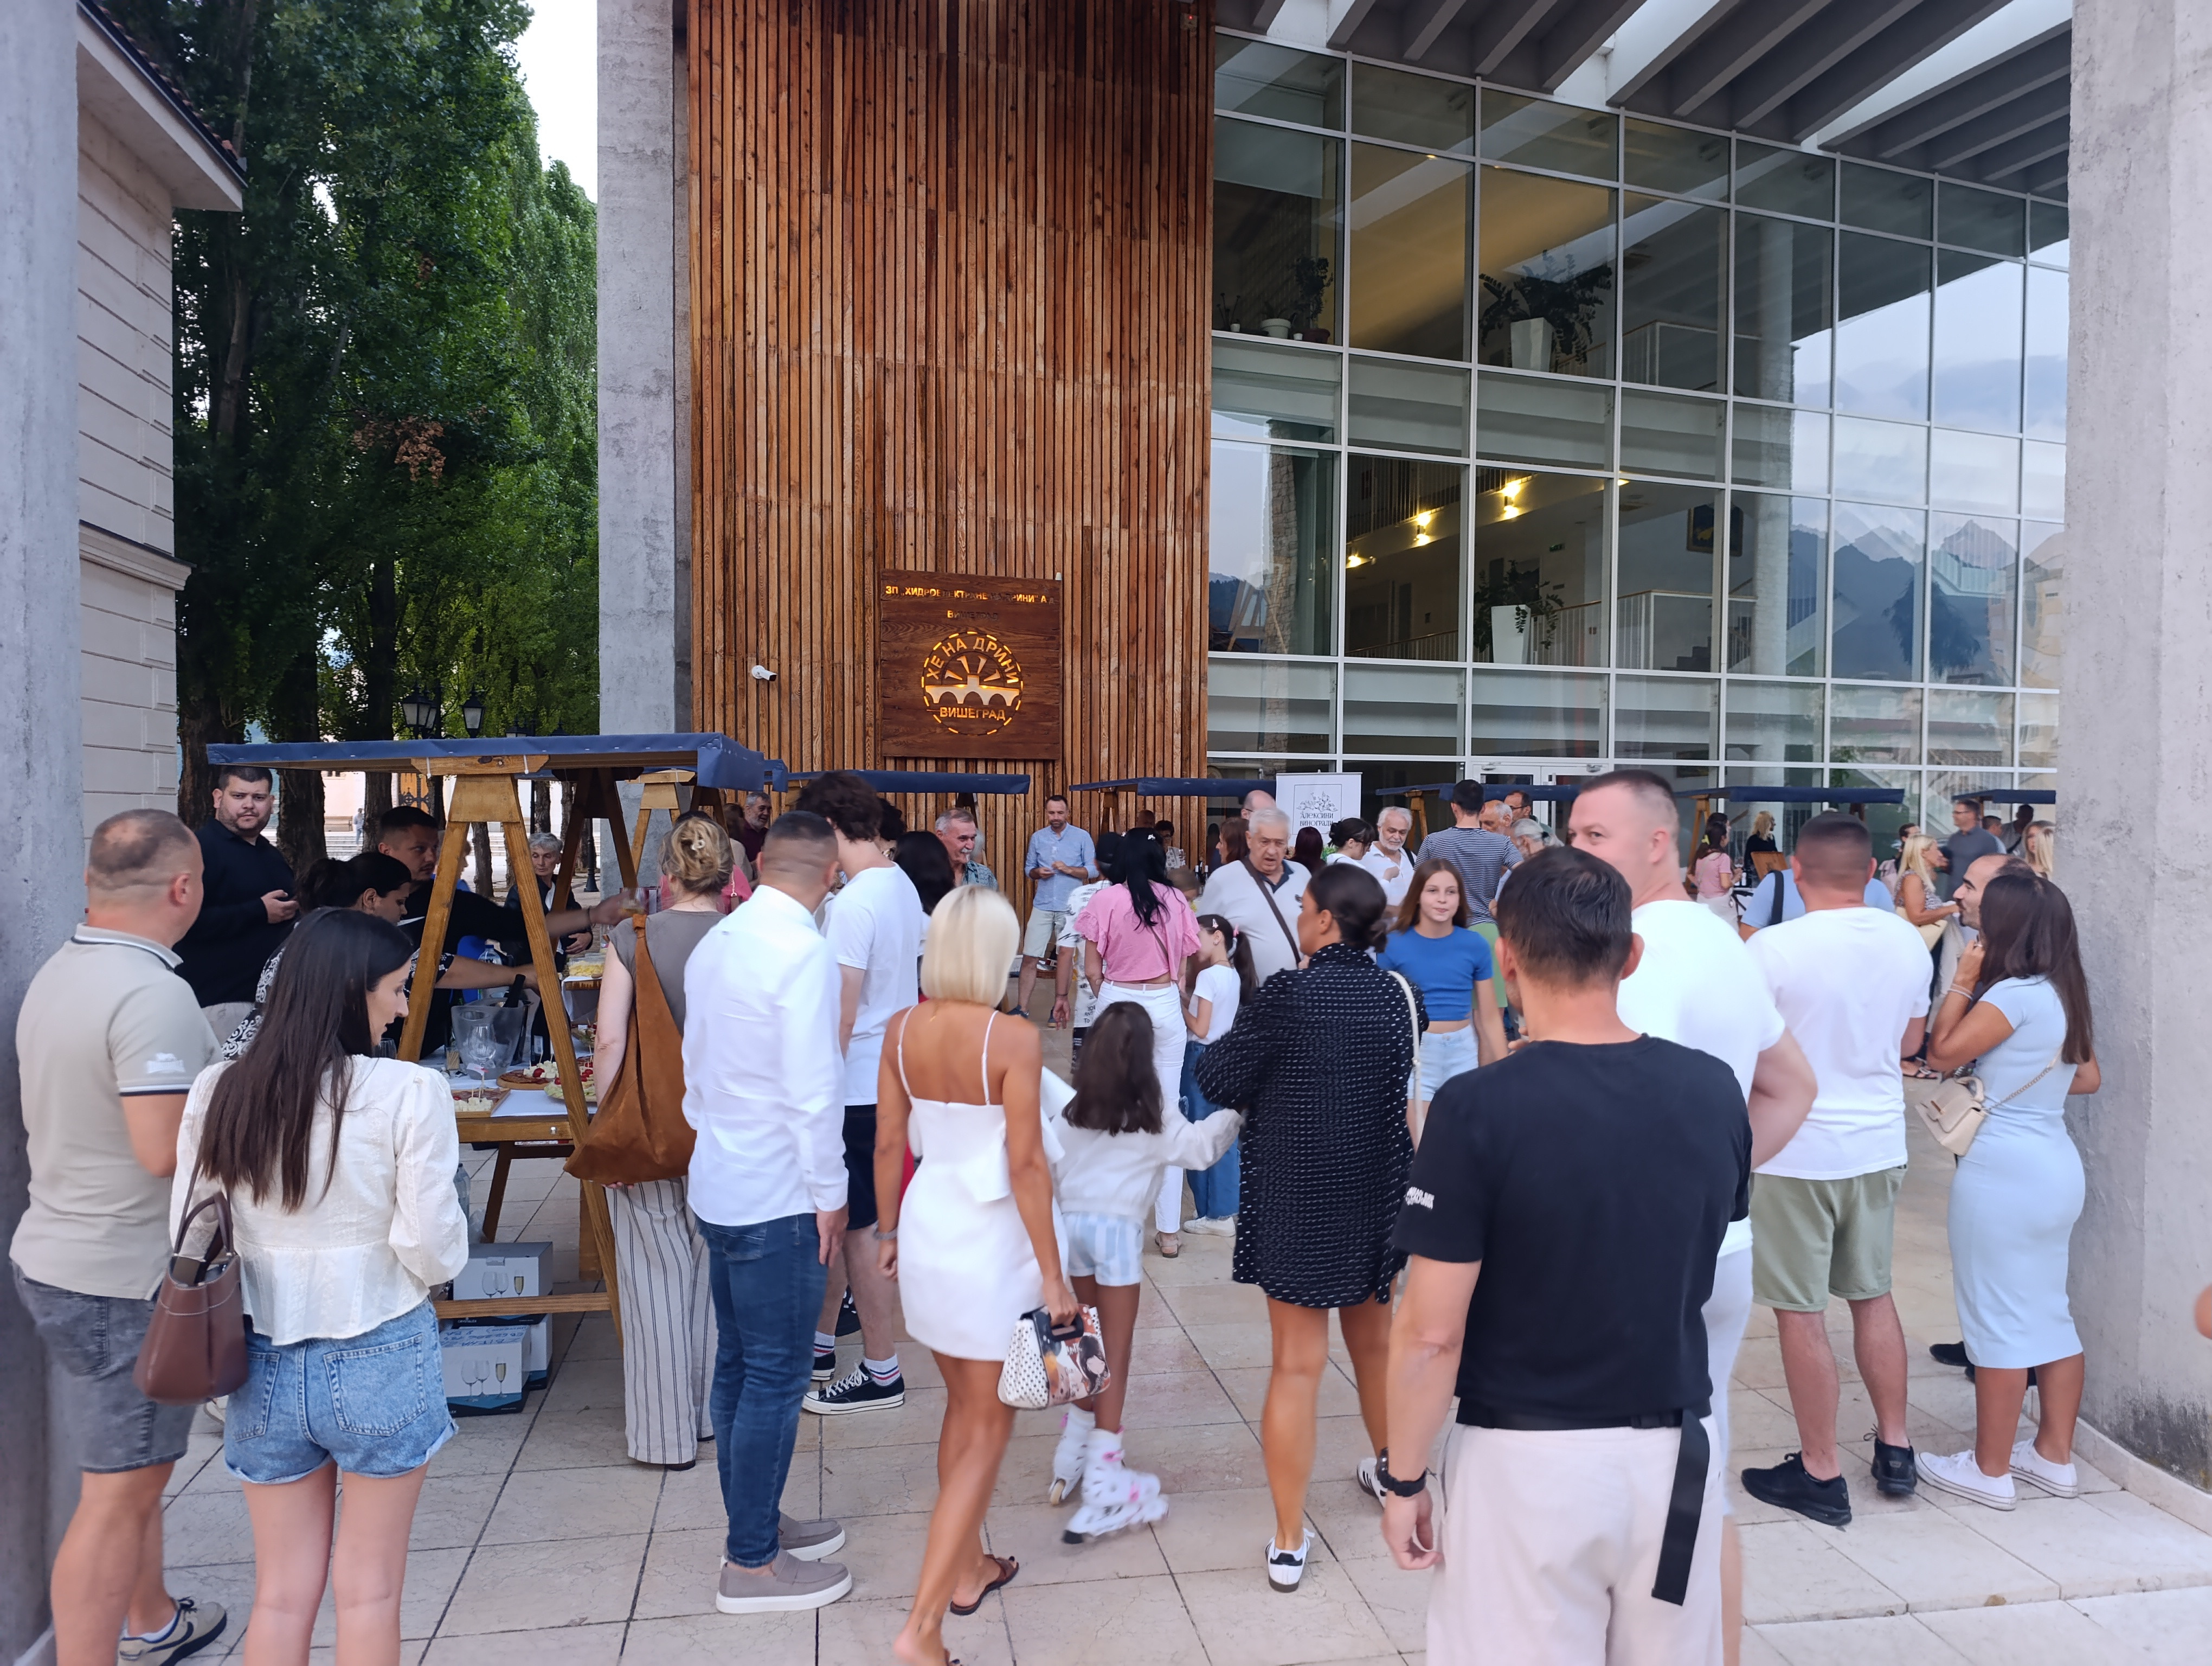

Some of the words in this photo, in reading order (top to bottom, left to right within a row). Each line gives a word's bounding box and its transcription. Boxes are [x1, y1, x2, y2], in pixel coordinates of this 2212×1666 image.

[885, 586, 898, 594] ЗП
[927, 655, 945, 680] ХЕ
[942, 638, 967, 657] НА
[973, 637, 1020, 684] ДРИНИ
[940, 707, 1006, 721] ВИШЕГРАД
